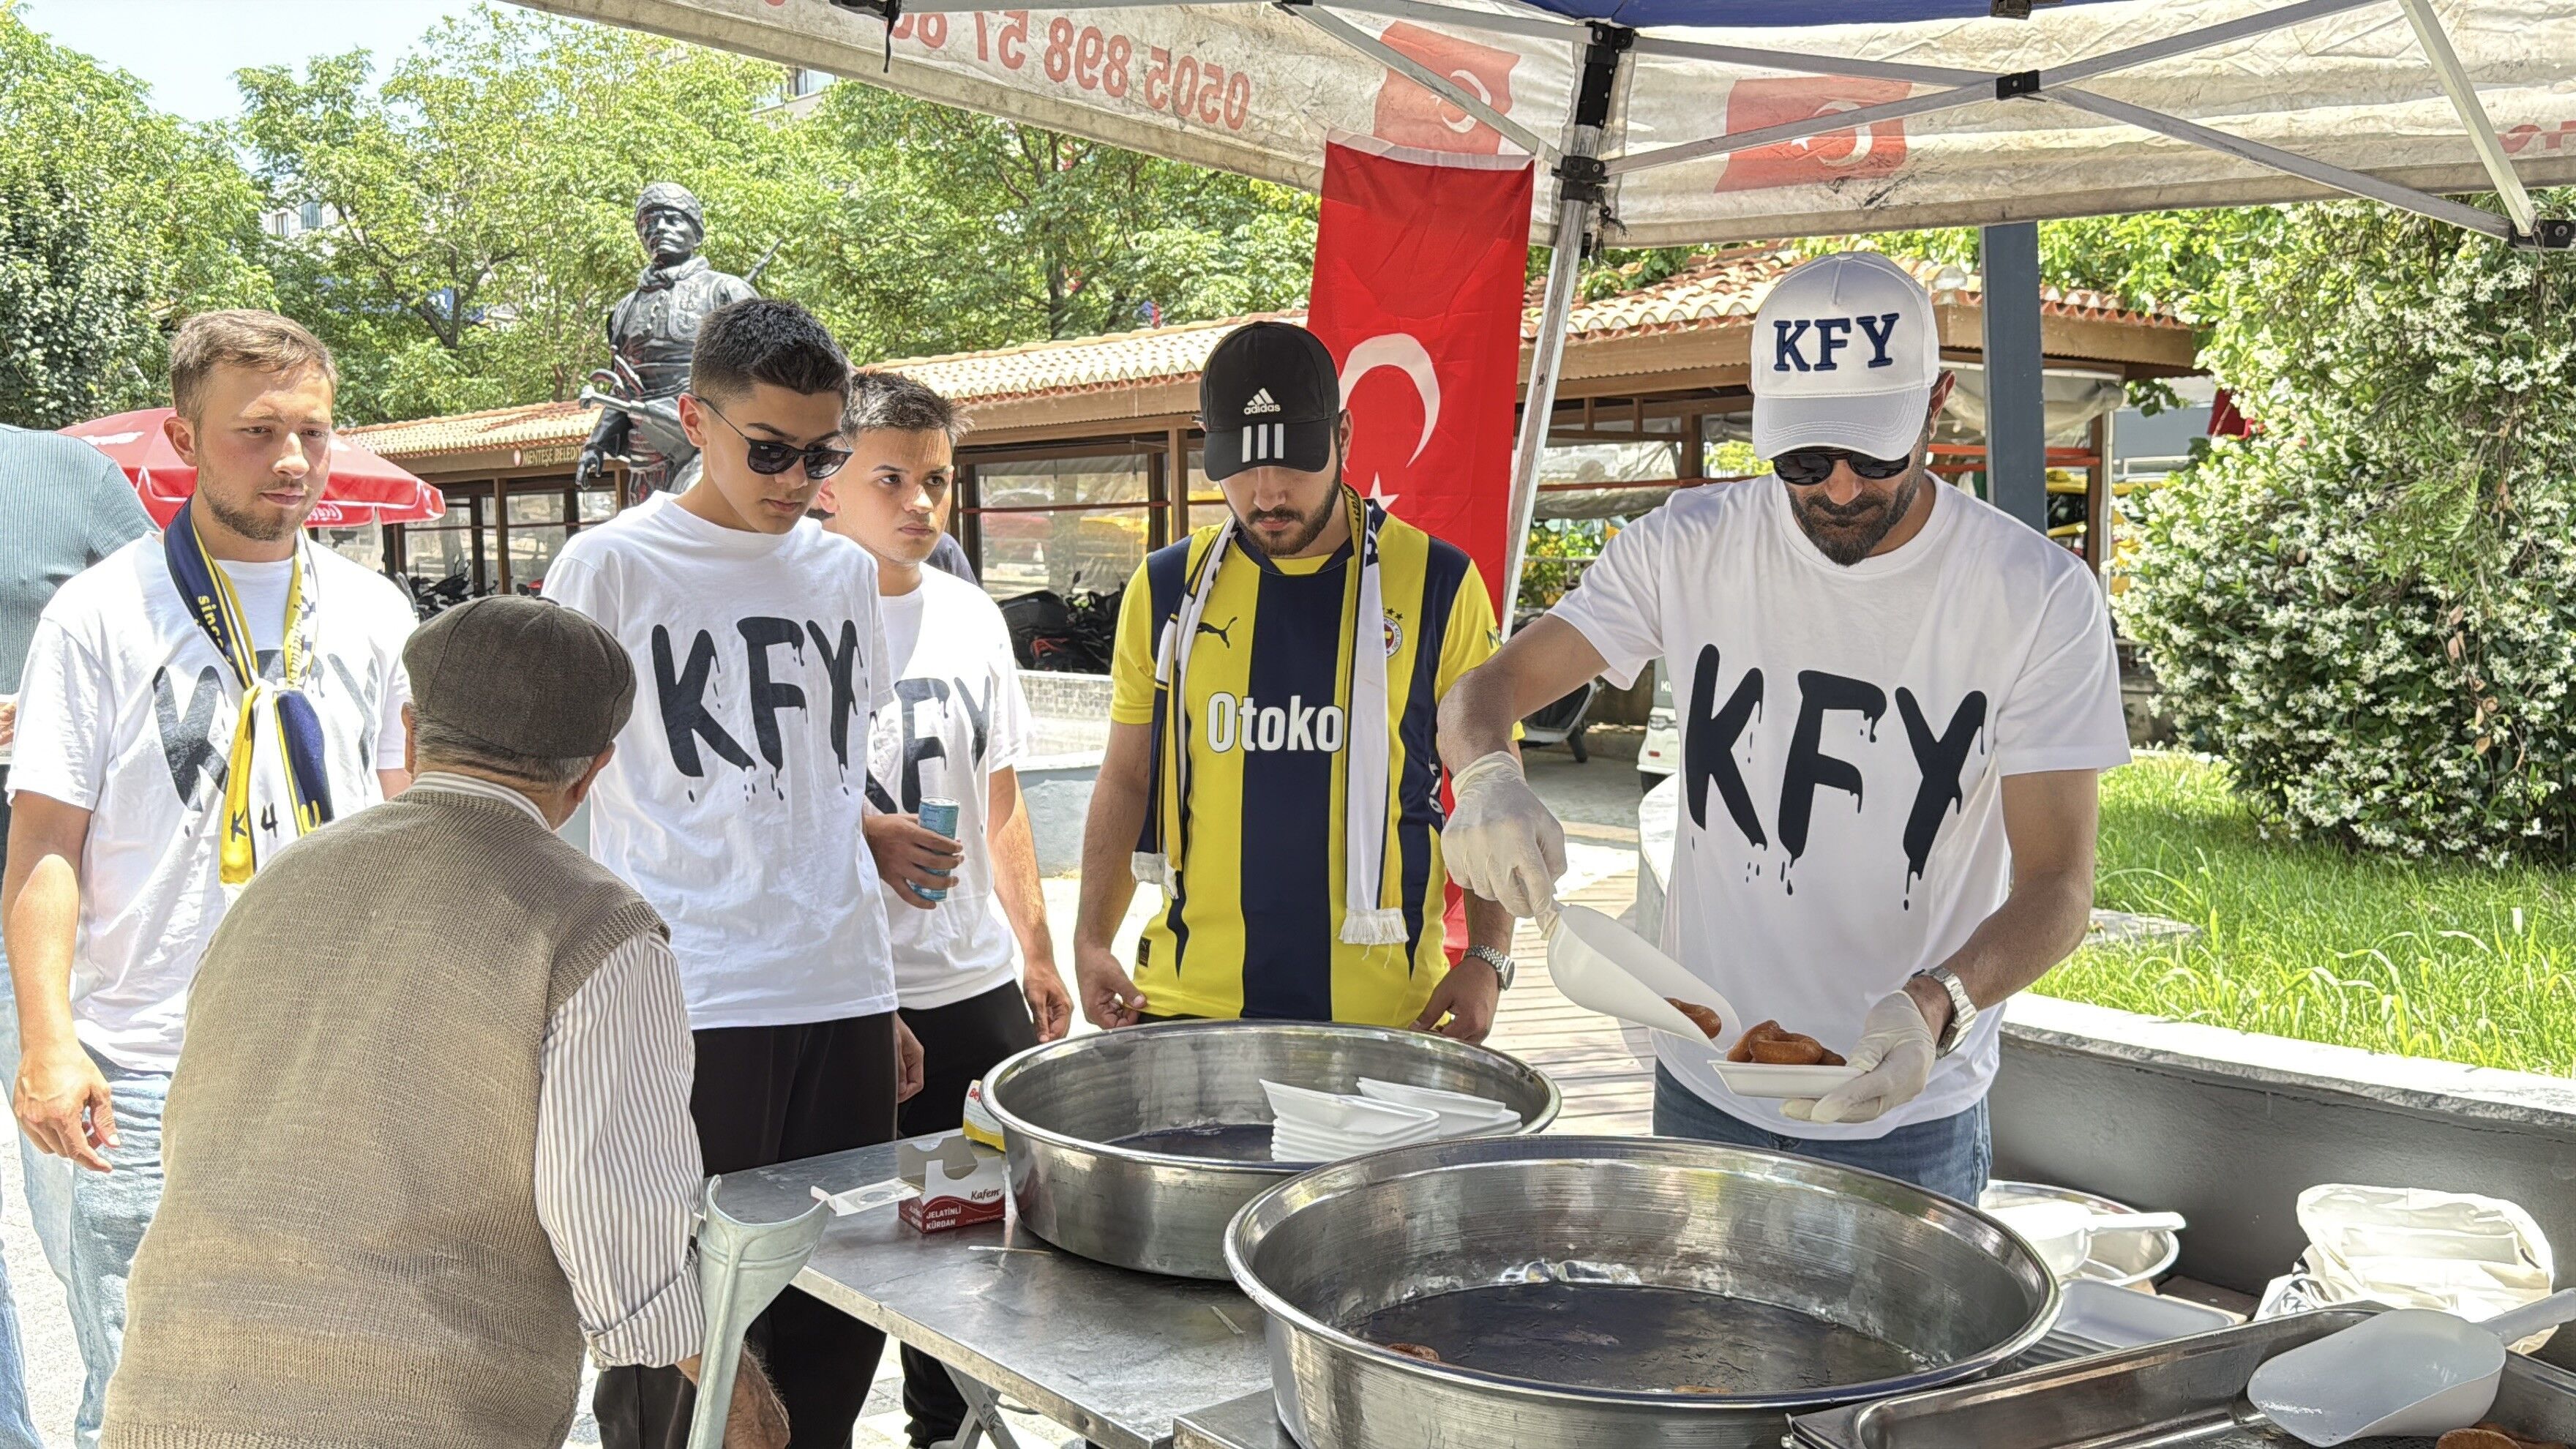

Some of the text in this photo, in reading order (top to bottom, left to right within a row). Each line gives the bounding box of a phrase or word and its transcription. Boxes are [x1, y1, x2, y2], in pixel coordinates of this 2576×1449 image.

[1772, 312, 1901, 372] KFY
[1243, 403, 1281, 415] adidas
[523, 445, 583, 467] MENTEŞE BELEDİY
[651, 616, 860, 794] KFY
[1207, 691, 1344, 753] Otoko
[1685, 643, 1988, 883] KFY
[231, 806, 248, 842] K
[261, 802, 278, 839] 4
[970, 1188, 1001, 1200] Kafem
[926, 1204, 962, 1219] JELATİNLİ
[926, 1218, 956, 1230] KÜRDAN
